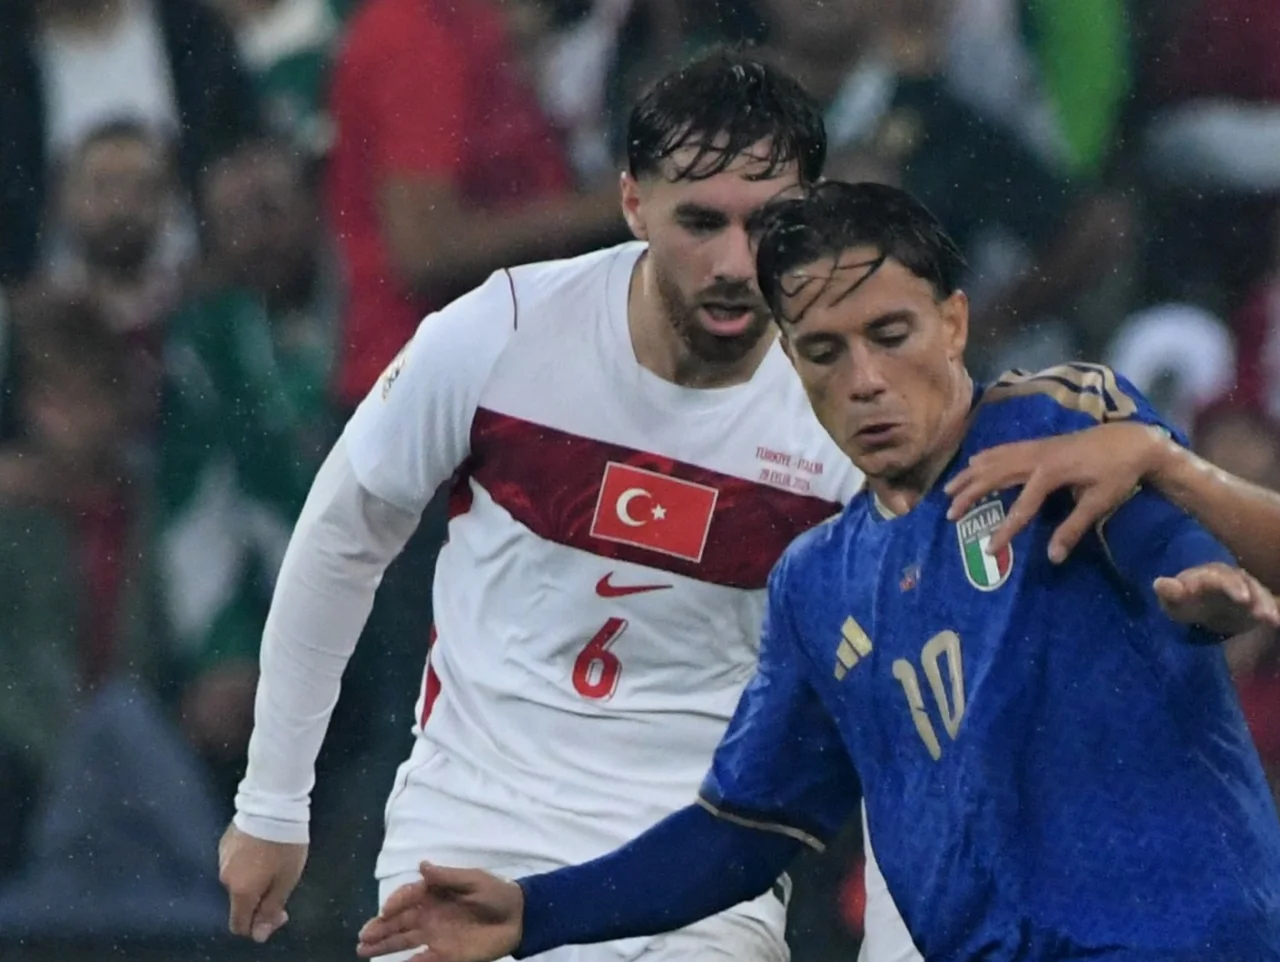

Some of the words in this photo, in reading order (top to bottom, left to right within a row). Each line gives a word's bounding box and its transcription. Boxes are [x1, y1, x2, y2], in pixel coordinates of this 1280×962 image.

[961, 508, 1001, 538] ITALIA
[572, 616, 629, 702] 6
[892, 629, 965, 761] 10
